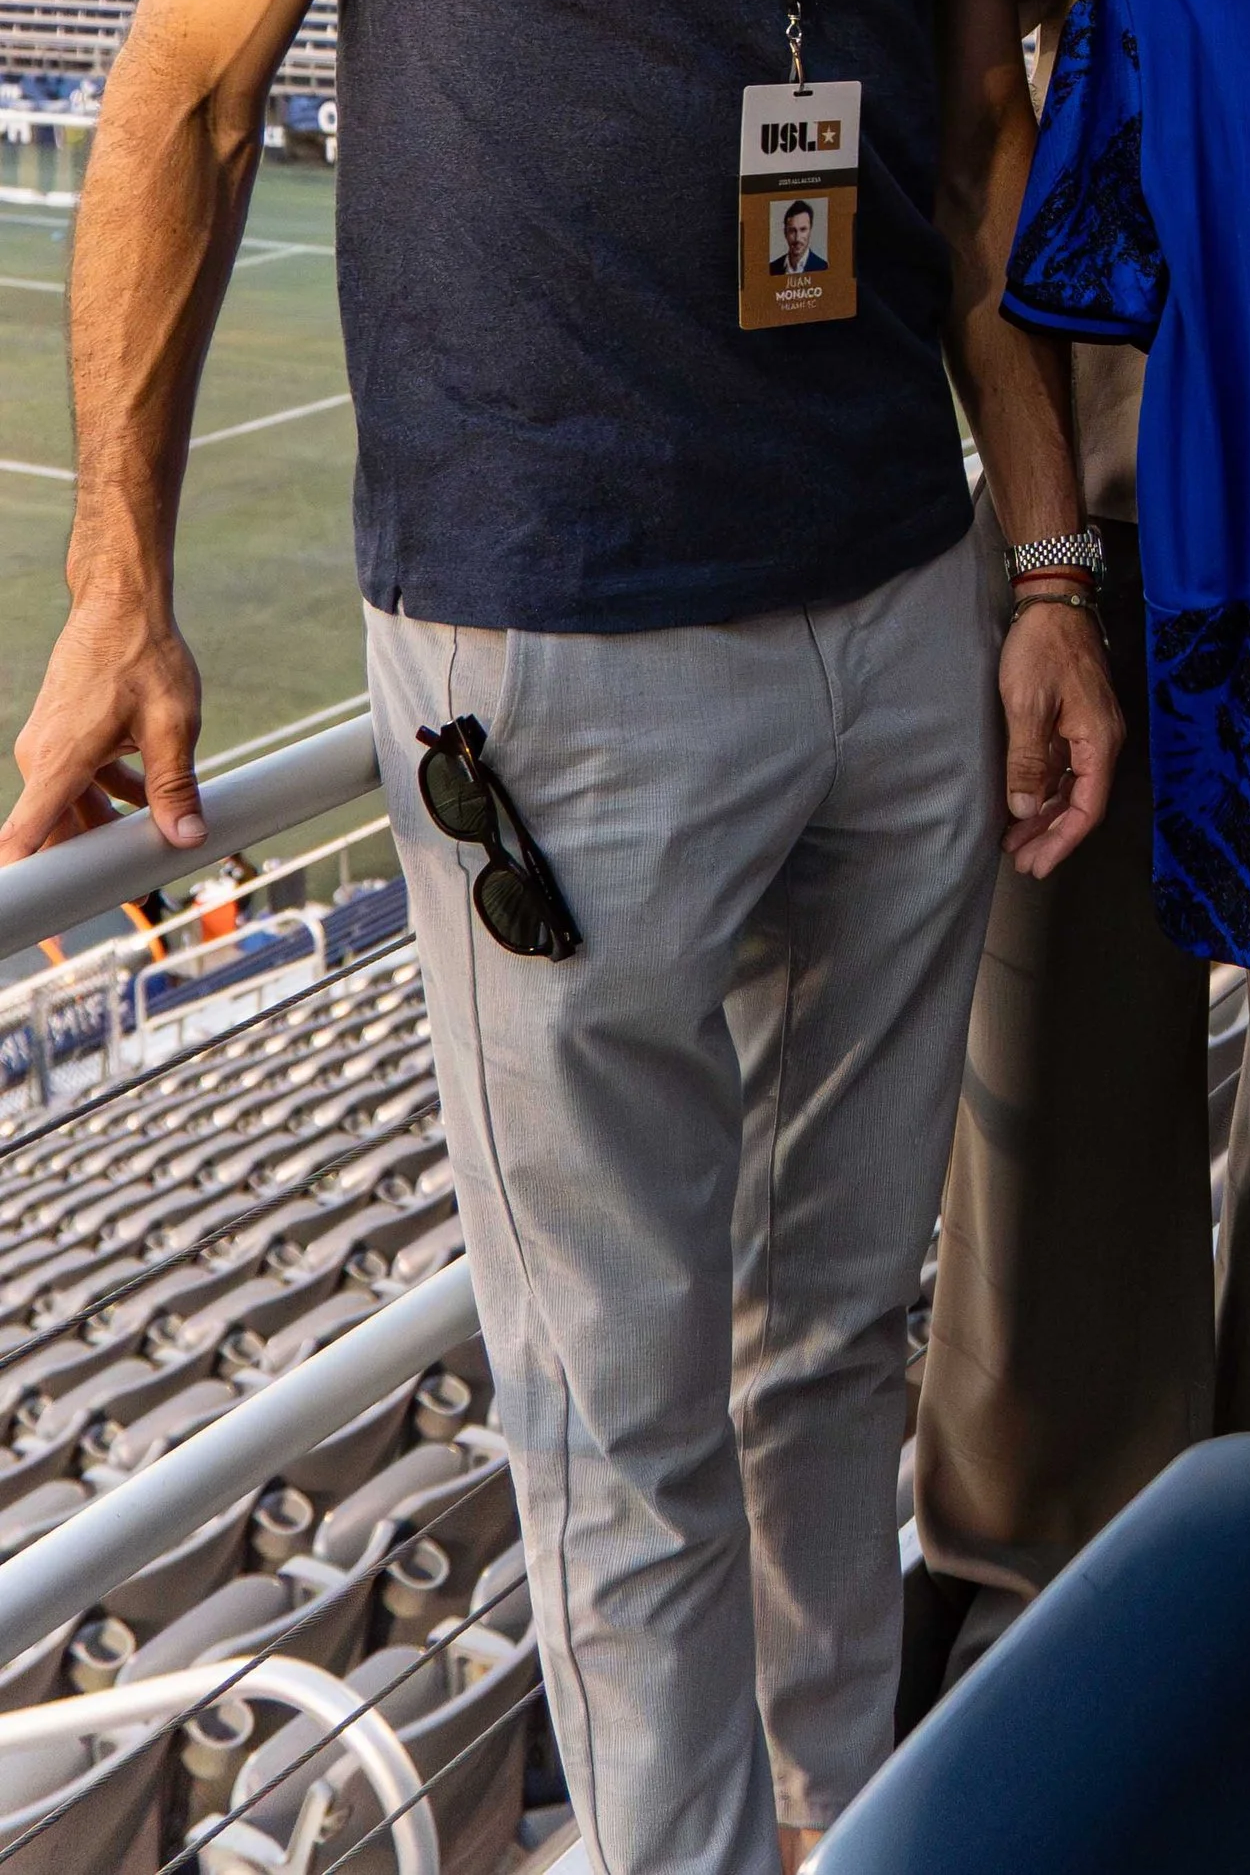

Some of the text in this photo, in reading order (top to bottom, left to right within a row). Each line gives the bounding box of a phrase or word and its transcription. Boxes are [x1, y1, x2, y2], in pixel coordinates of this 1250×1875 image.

[761, 122, 816, 155] USL
[786, 276, 811, 288] JUAN
[776, 287, 822, 301] MONACO
